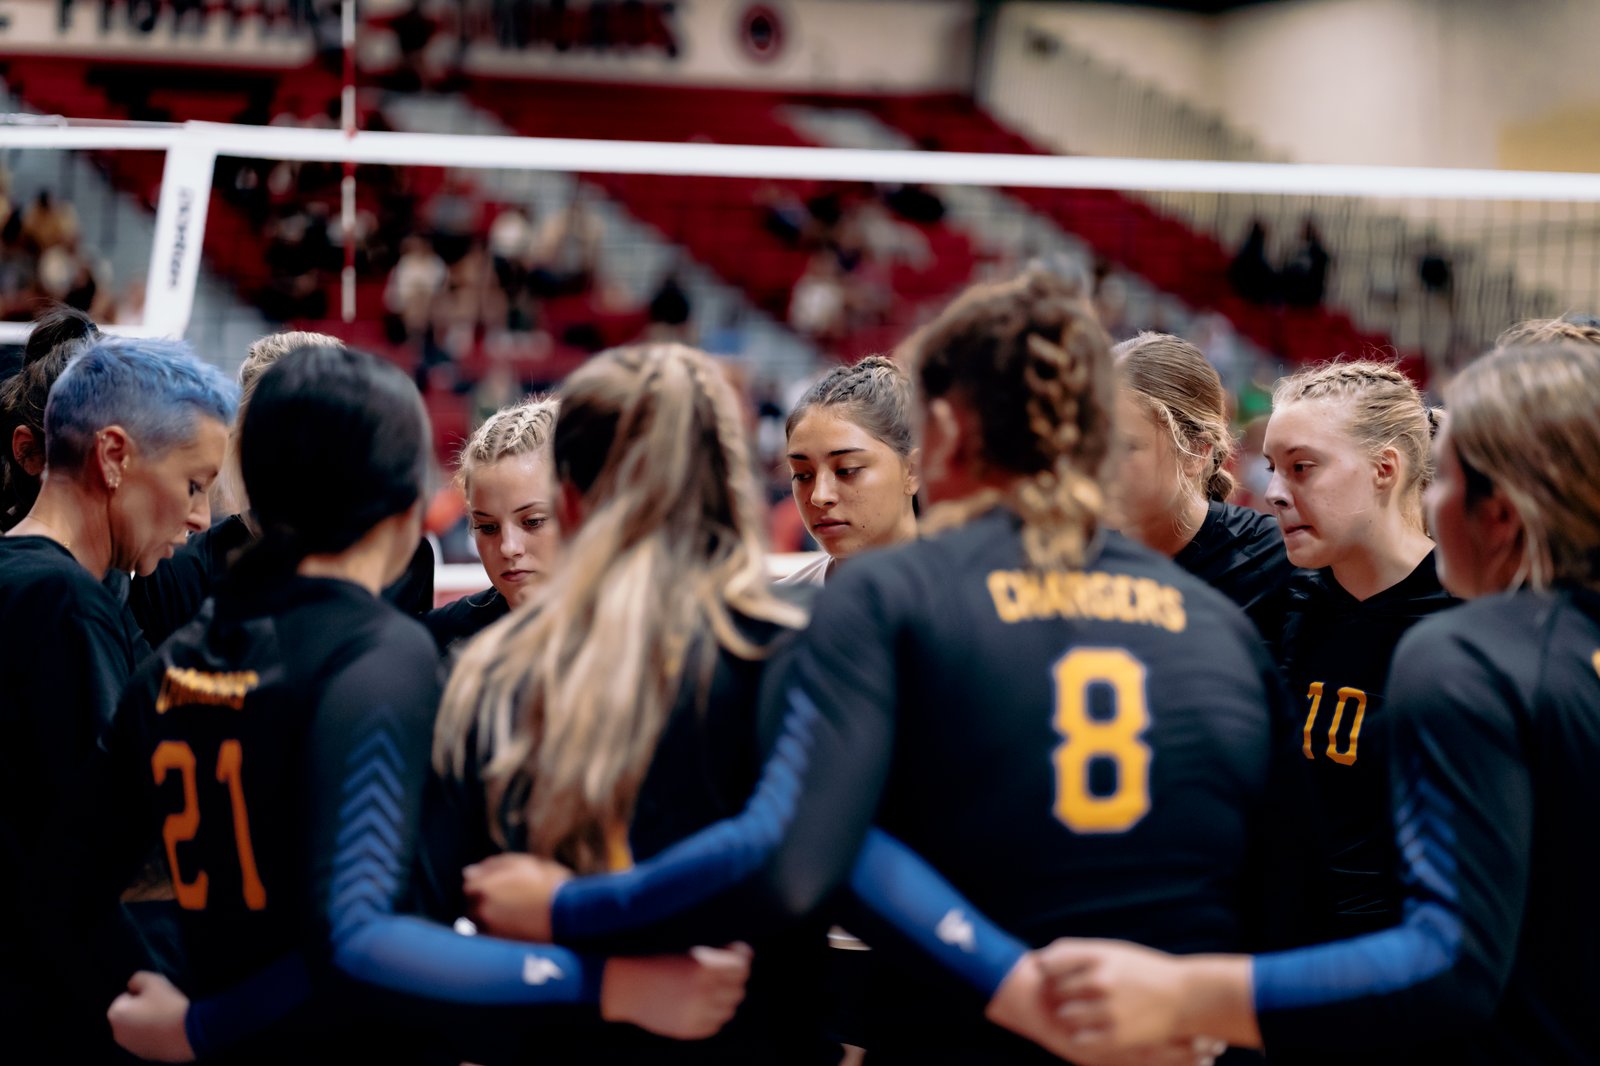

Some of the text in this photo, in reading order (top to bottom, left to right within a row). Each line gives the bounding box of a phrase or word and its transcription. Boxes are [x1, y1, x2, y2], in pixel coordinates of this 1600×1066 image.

[1052, 646, 1153, 834] 8
[1302, 681, 1367, 766] 10
[152, 739, 267, 910] 21
